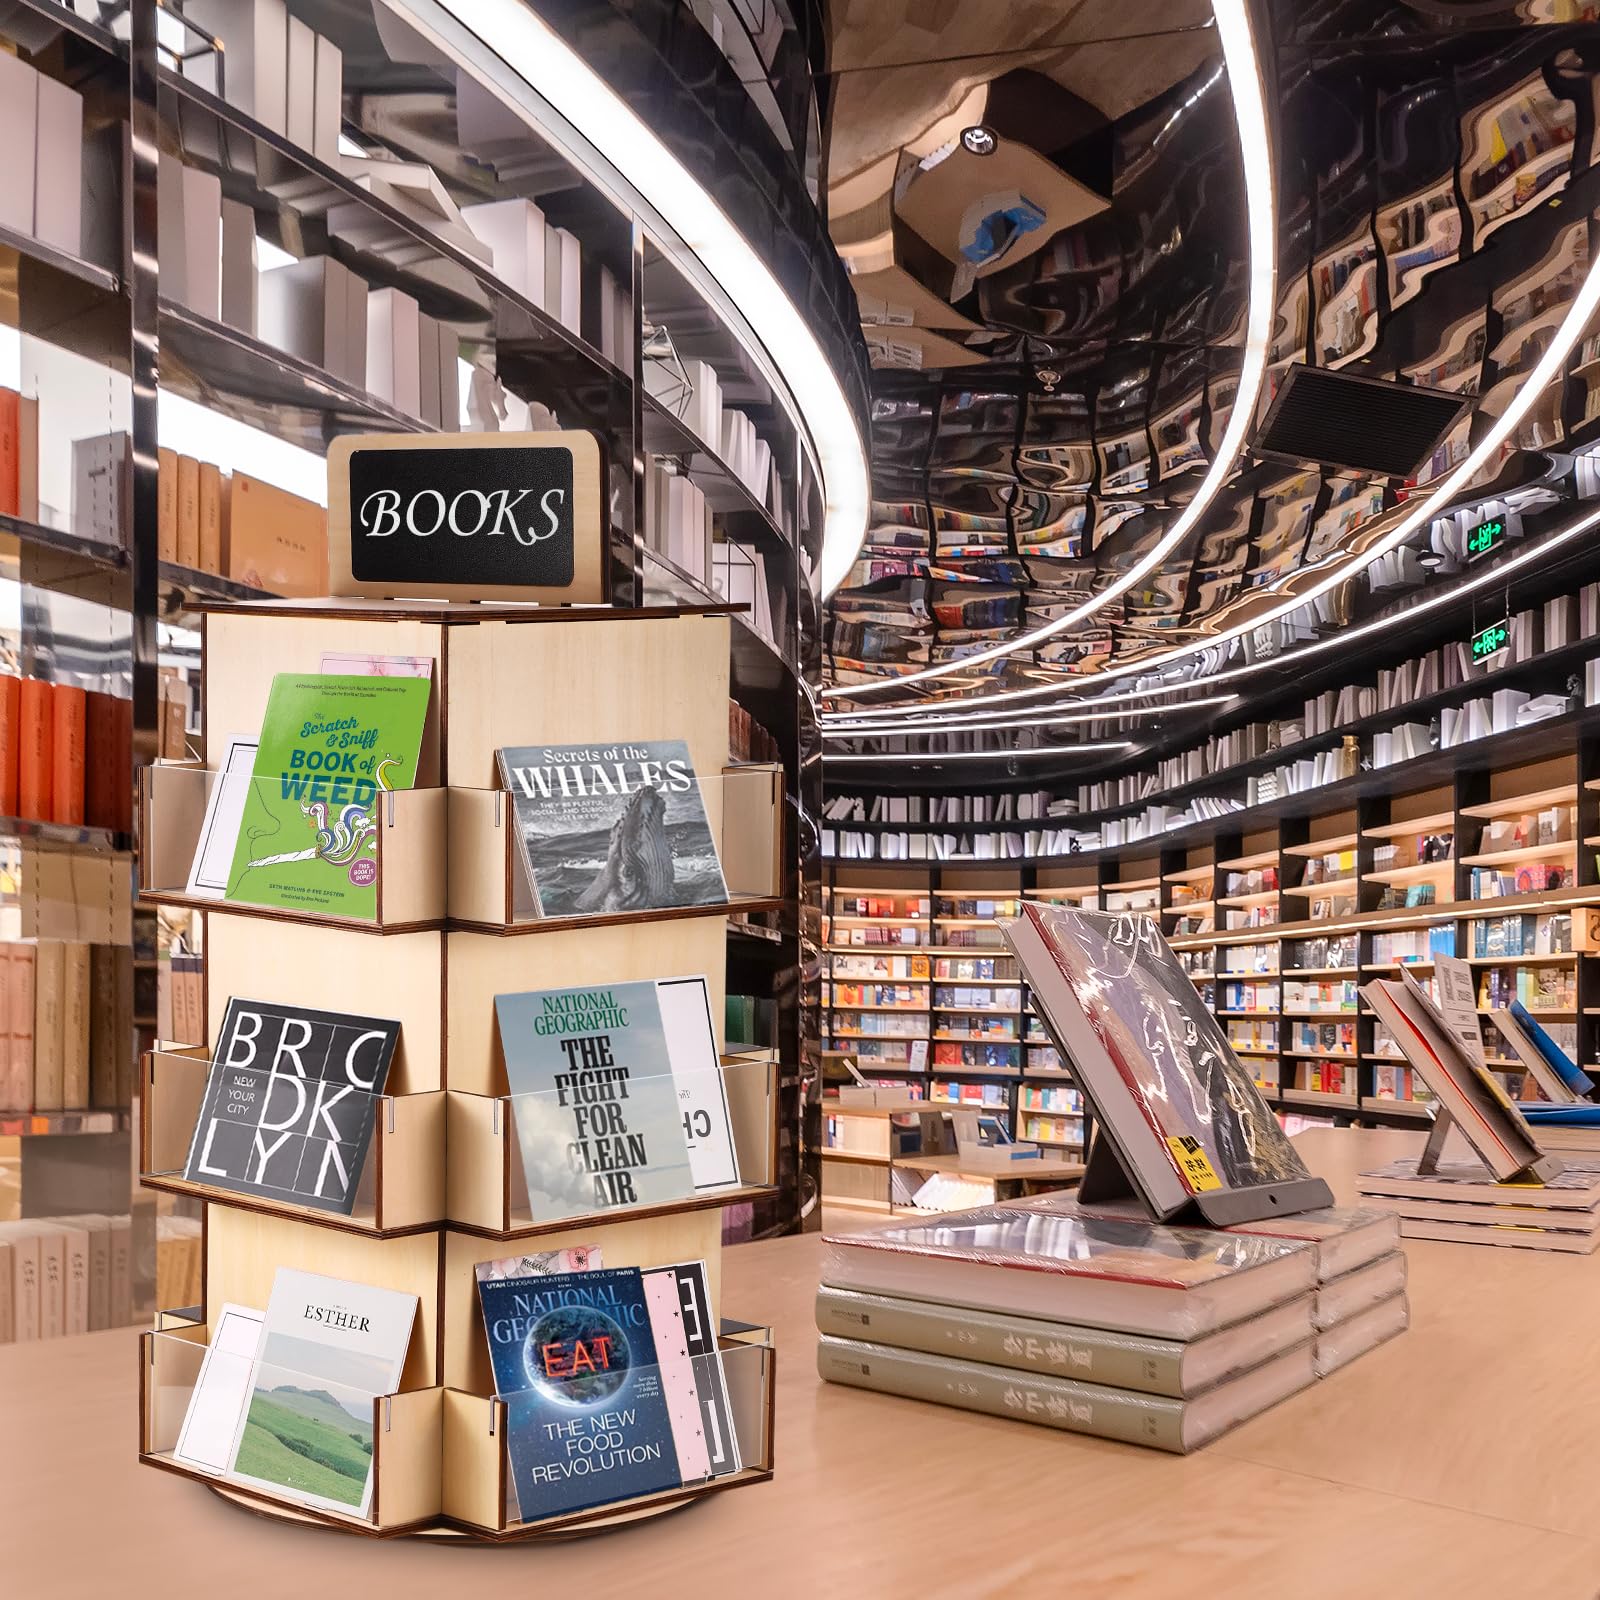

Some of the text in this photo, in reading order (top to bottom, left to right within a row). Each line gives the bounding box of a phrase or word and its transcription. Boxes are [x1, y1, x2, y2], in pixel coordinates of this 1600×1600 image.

[360, 489, 565, 546] BOOKS
[300, 717, 359, 738] Scratch
[326, 728, 378, 749] & Sniff
[290, 749, 376, 775] BOOK of
[543, 746, 648, 764] Secrets of the
[281, 772, 376, 807] WEED
[512, 760, 692, 799] WHALES
[542, 991, 618, 1014] NATIONAL
[534, 1008, 630, 1036] GEOGRAPHIC
[560, 1035, 614, 1071] THE
[228, 1089, 255, 1103] YOUR
[234, 1075, 256, 1088] NEW
[554, 1067, 630, 1107] FIGHT
[227, 1103, 249, 1115] CITY
[573, 1102, 627, 1139] FOR
[567, 1133, 648, 1174] CLEAN
[594, 1171, 637, 1206] AIR
[513, 1285, 622, 1316] NATIONAL
[304, 1304, 369, 1332] ESTHER
[542, 1337, 612, 1377] EAT
[544, 1409, 636, 1441] THE NEW
[566, 1431, 624, 1457] FOOD
[532, 1443, 661, 1484] REVOLUTION
